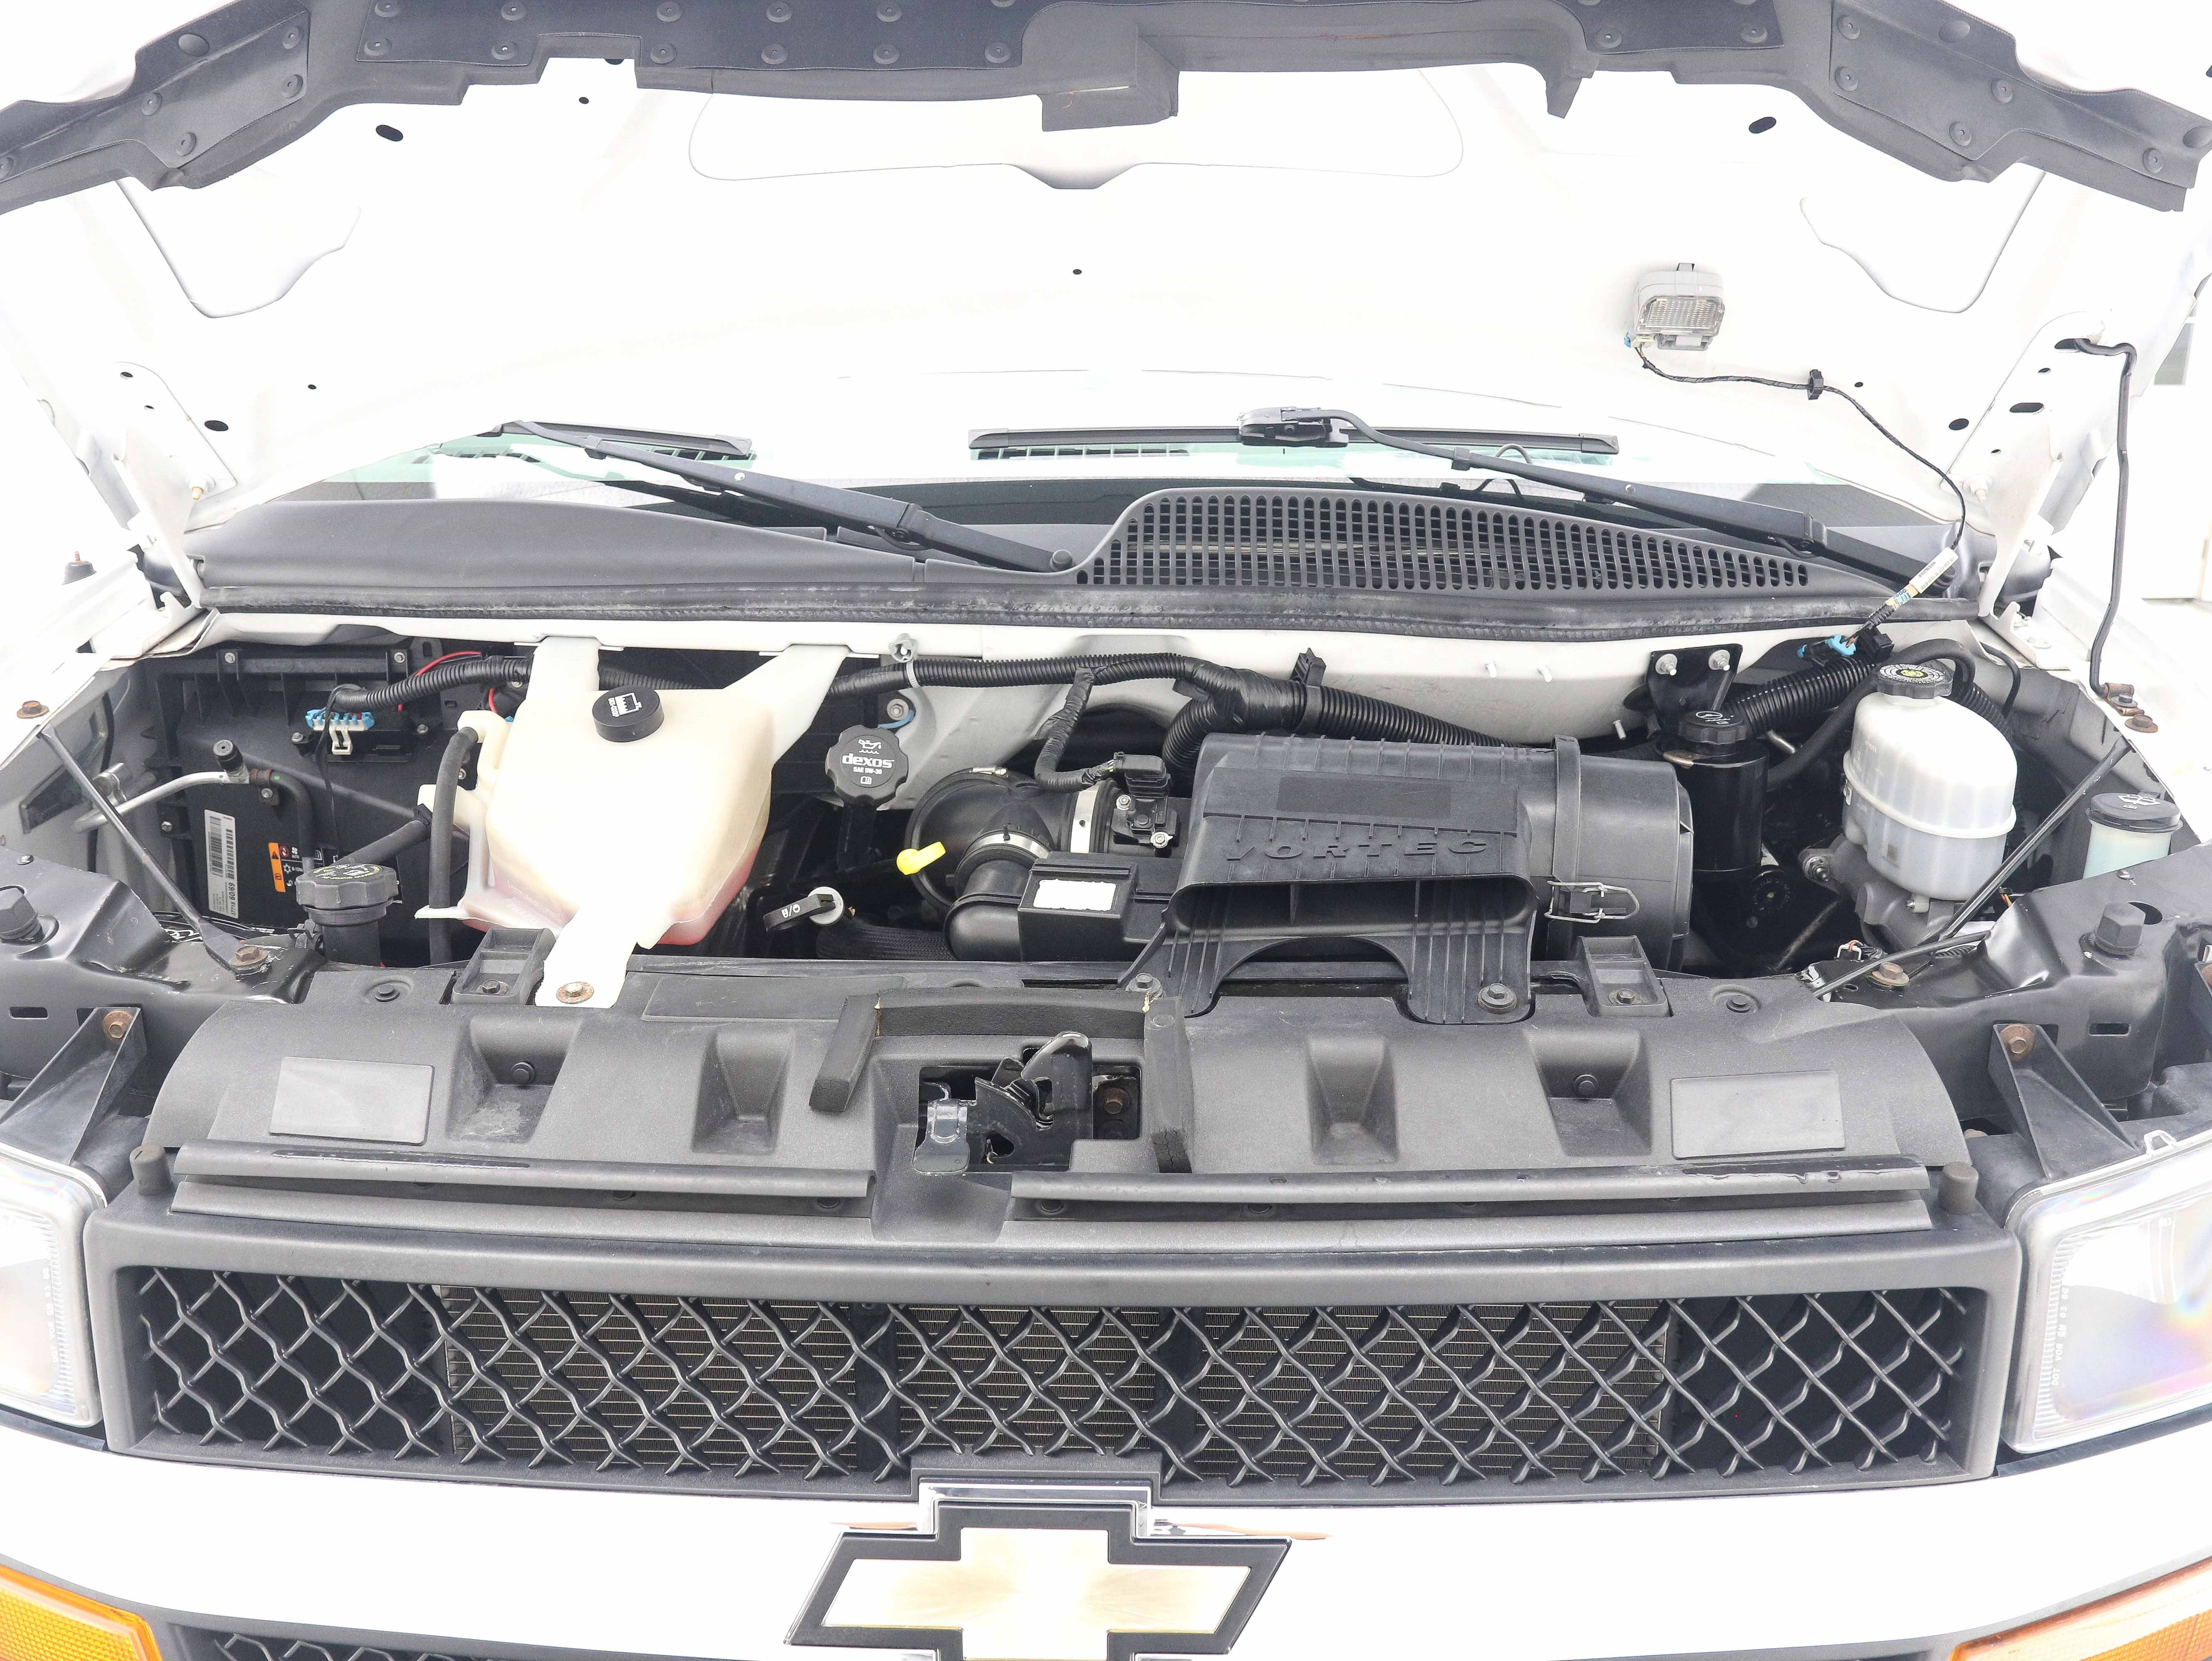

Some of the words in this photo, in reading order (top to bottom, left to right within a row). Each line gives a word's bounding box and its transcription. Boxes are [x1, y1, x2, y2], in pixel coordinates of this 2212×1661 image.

[842, 753, 893, 768] dexos
[1224, 838, 1486, 861] VORTEC
[2060, 1306, 2067, 1318] 03
[2055, 1343, 2063, 1361] VOR
[2052, 1368, 2060, 1386] DOT
